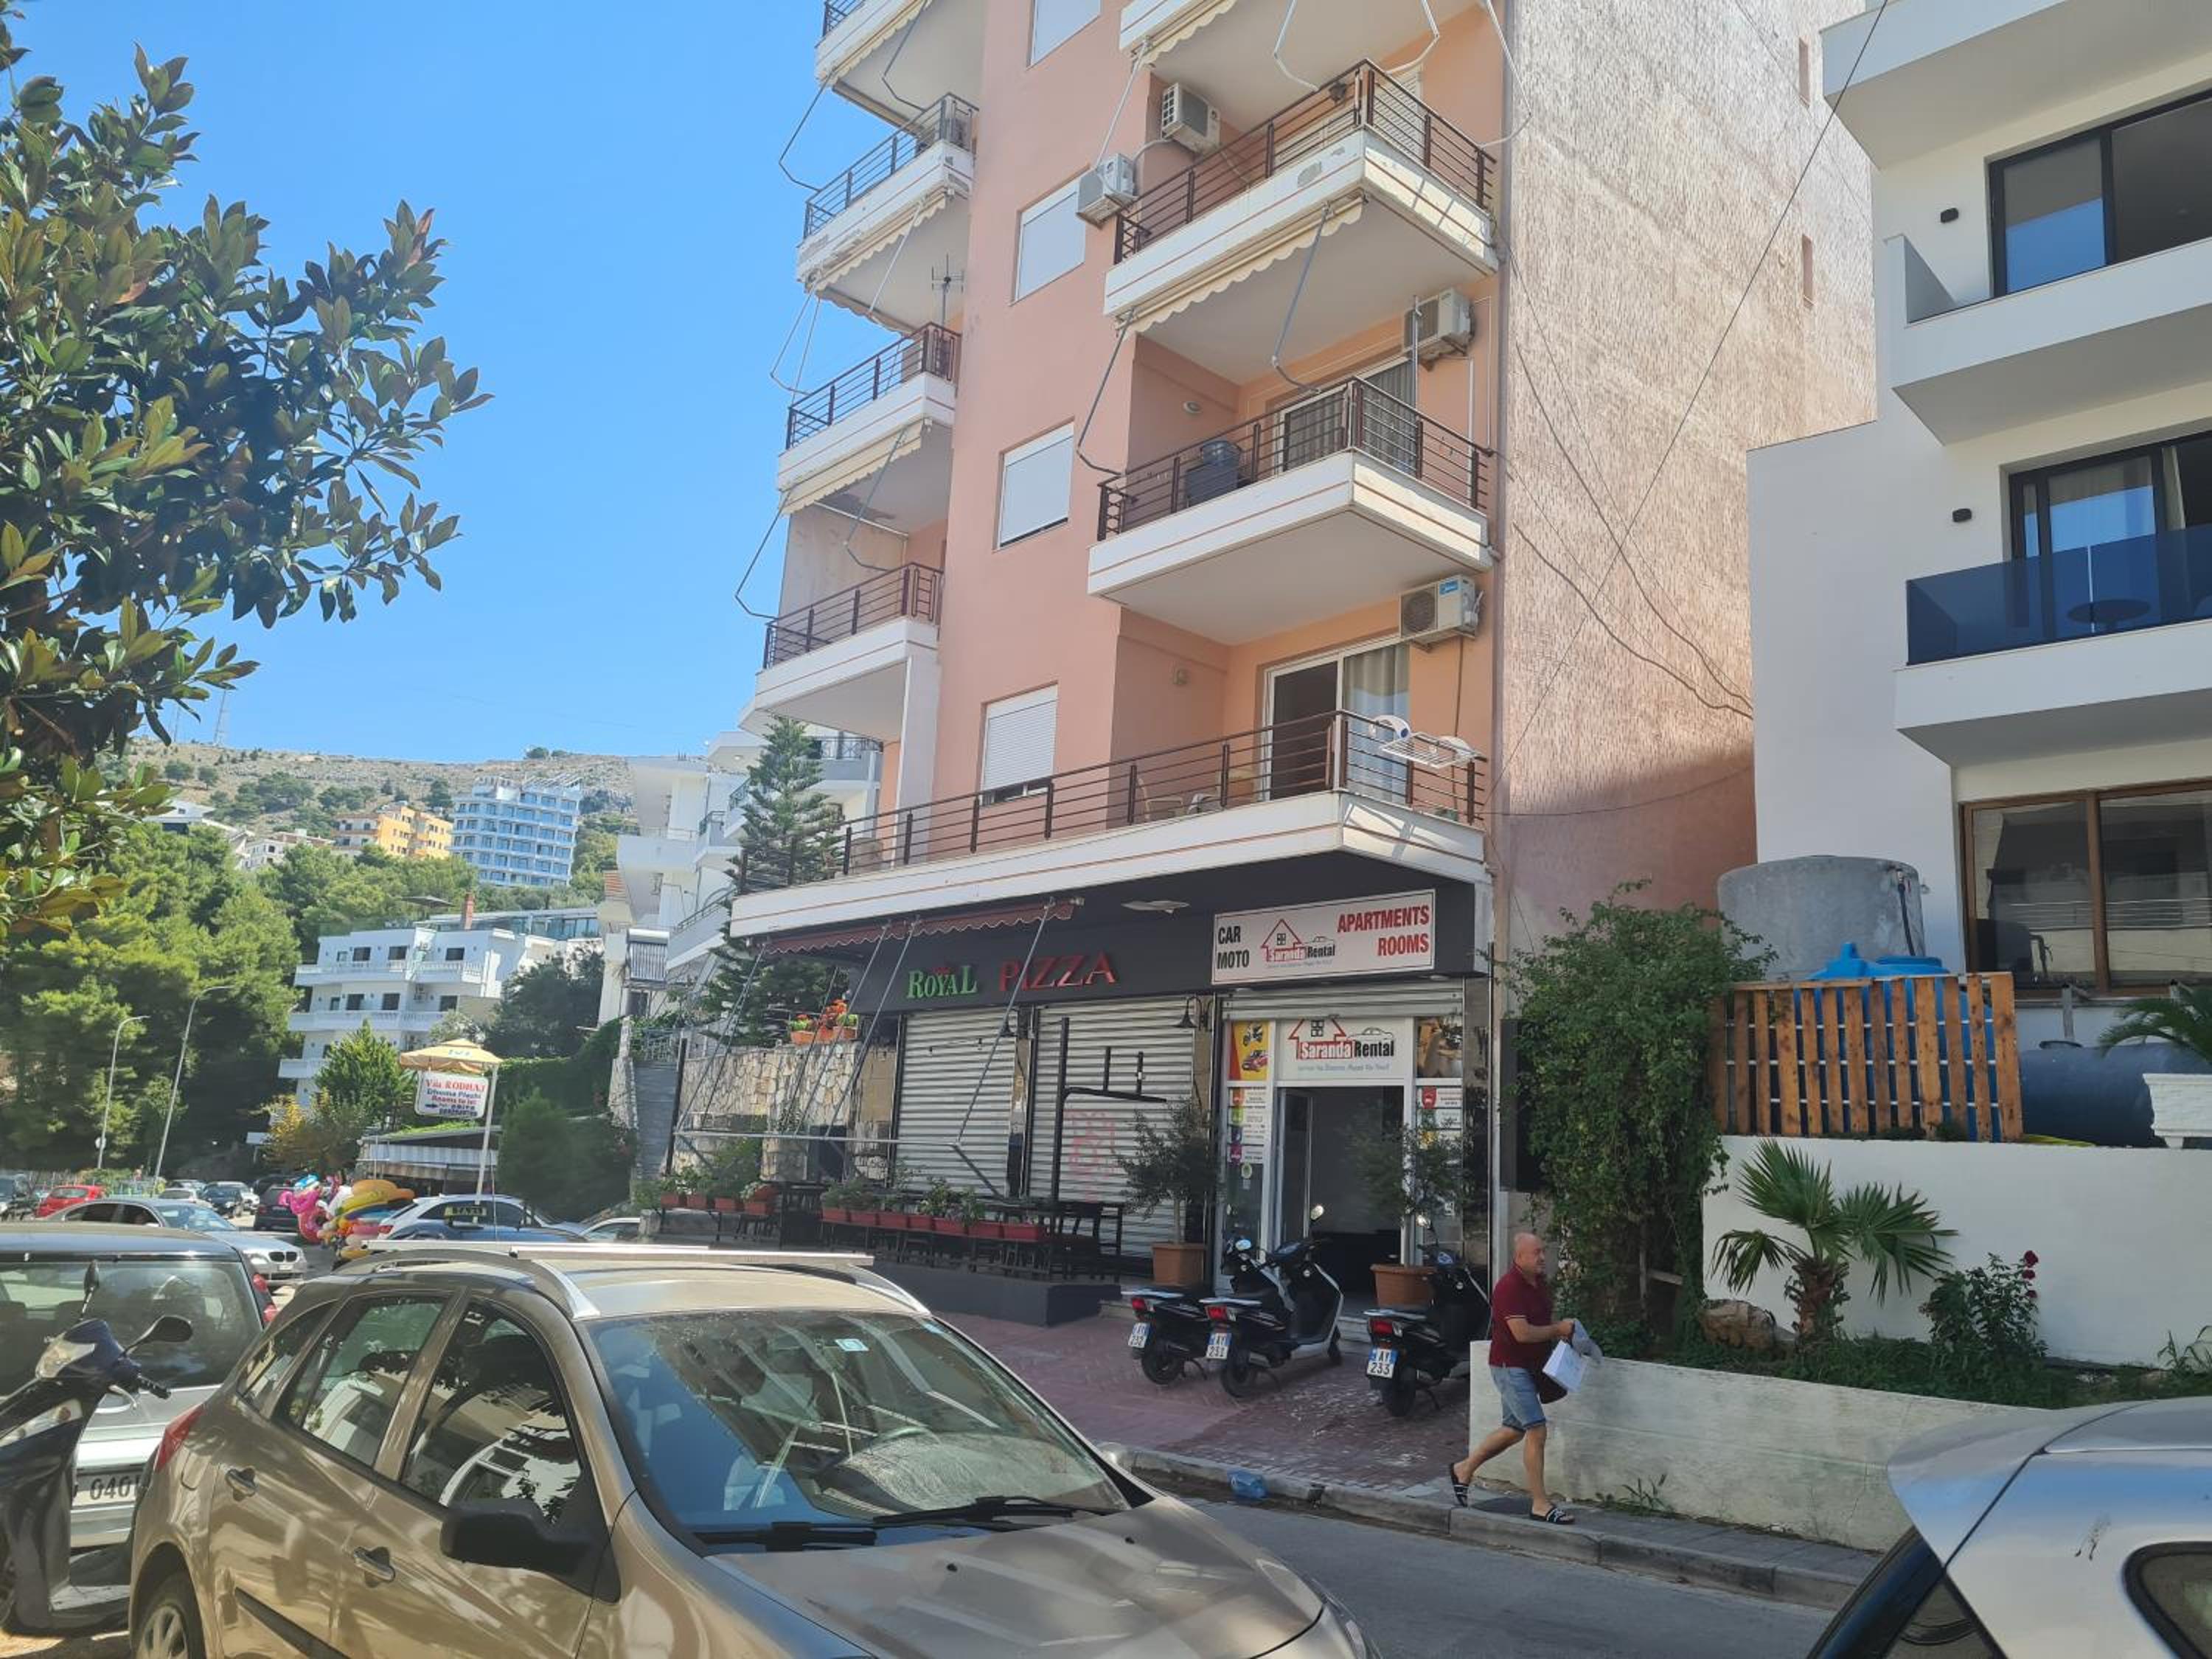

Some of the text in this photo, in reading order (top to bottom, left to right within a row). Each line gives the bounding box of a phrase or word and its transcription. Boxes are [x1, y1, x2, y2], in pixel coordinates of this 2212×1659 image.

[1337, 905, 1430, 933] APARTMENTS
[1218, 926, 1242, 945] CAR
[1377, 933, 1429, 956] ROOMS
[1217, 950, 1250, 970] MOTO
[1307, 945, 1336, 959] Rental
[999, 953, 1116, 992] PIZZA
[1301, 1040, 1394, 1059] Saranda Rental
[1370, 1362, 1390, 1375] 233
